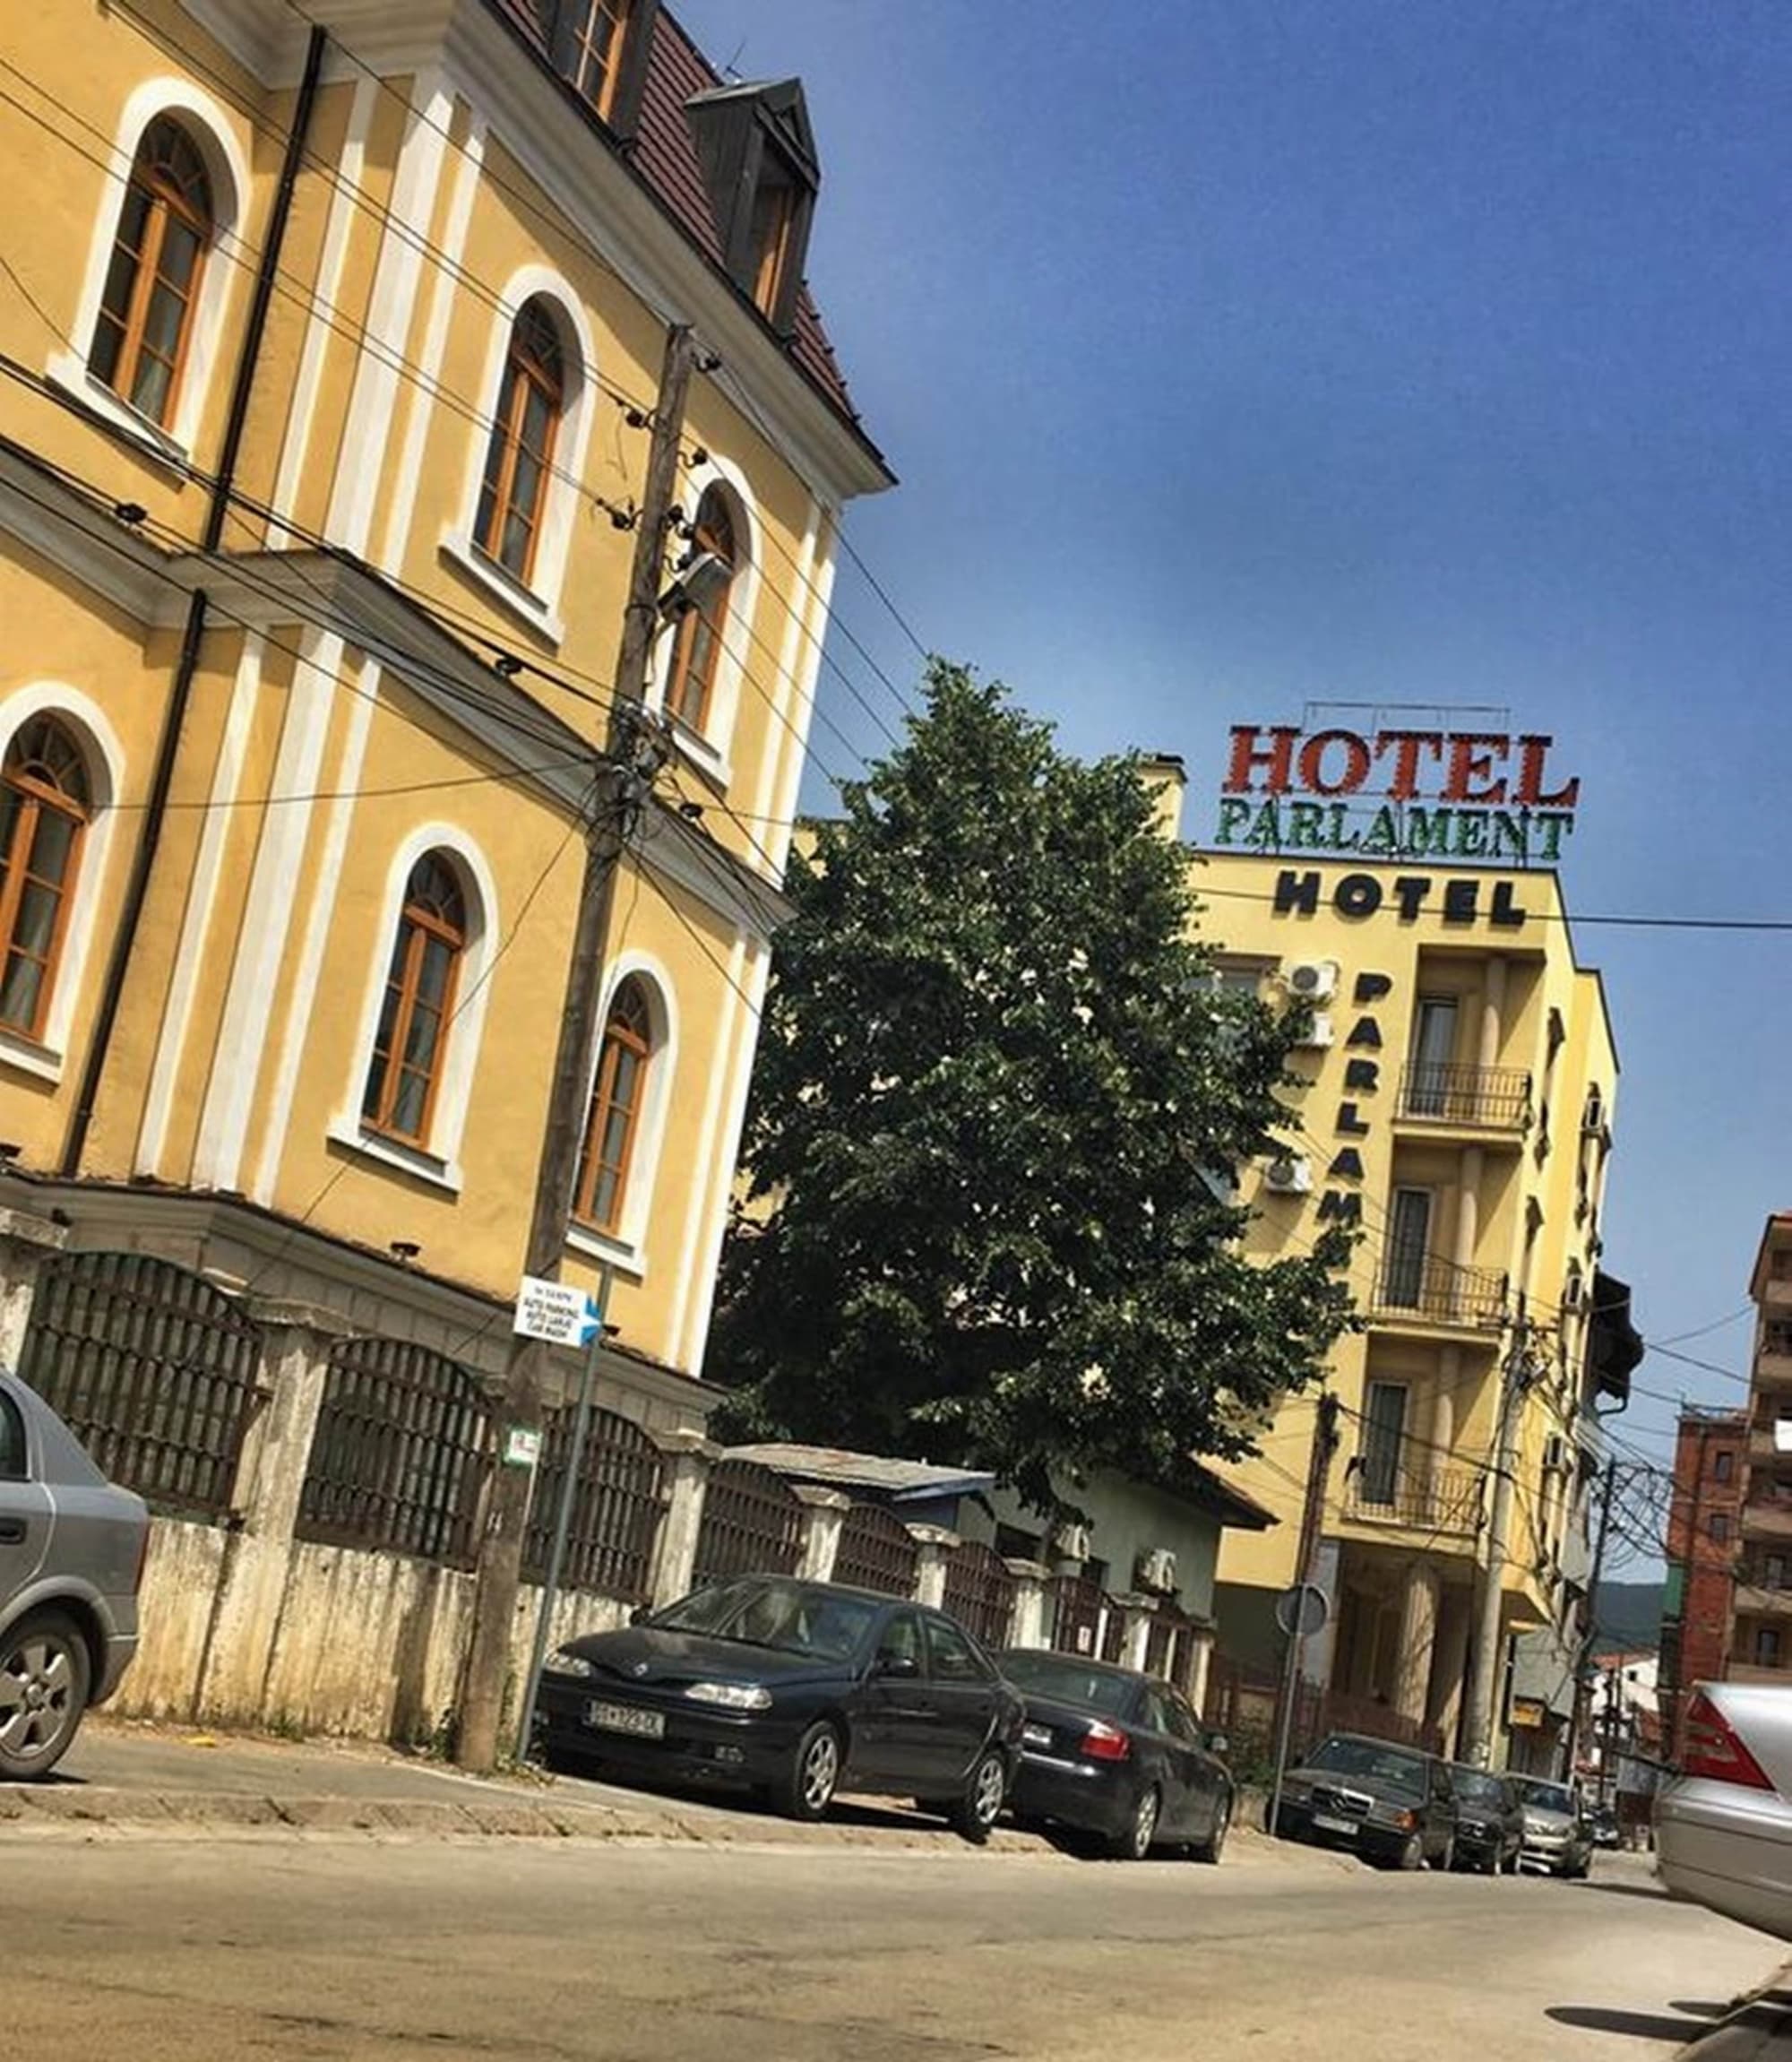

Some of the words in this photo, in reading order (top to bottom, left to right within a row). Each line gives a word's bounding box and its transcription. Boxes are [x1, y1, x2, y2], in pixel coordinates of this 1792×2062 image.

[1220, 726, 1580, 807] HOTEL
[1214, 798, 1573, 860] PARLAMENT
[1271, 870, 1527, 926] HOTEL
